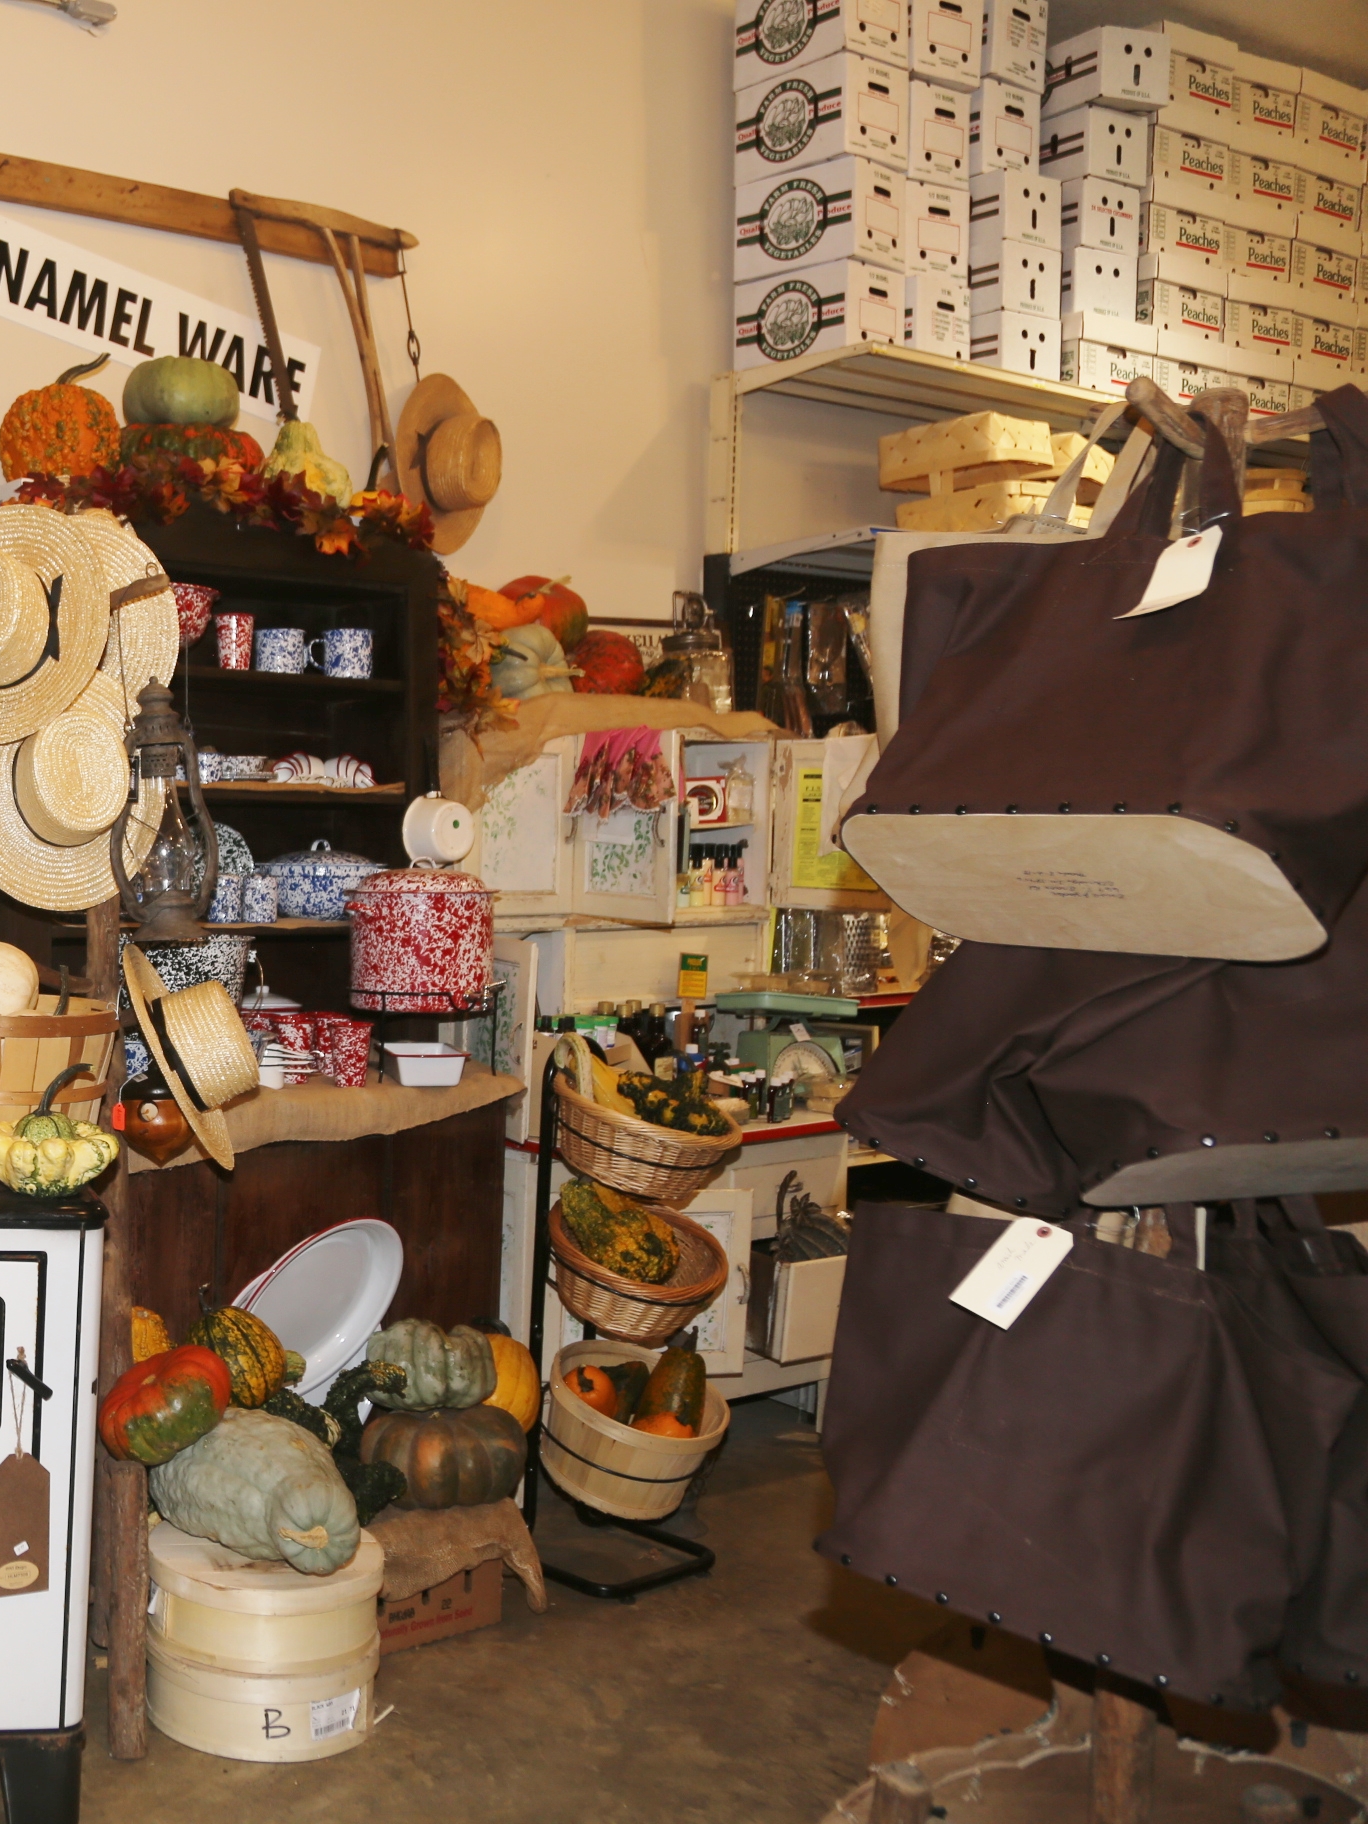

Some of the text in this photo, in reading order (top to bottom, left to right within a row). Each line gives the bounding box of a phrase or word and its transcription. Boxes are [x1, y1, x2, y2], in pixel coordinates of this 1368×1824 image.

[807, 0, 840, 15] Poduce
[759, 28, 813, 64] VEGETABLES
[760, 80, 815, 114] FARM FRESH
[1188, 74, 1230, 101] Peaches
[808, 100, 842, 117] Poduce
[1252, 100, 1292, 123] Peaches
[760, 127, 813, 161] VEGETABLES
[1321, 121, 1359, 147] Peaches
[1182, 150, 1224, 175] Peaches
[1252, 172, 1292, 195] Peaches
[764, 180, 824, 211] FARM FRESH
[1316, 192, 1354, 217] Peaches
[817, 202, 852, 218] Poduce
[764, 229, 822, 260] VEGETABLES
[1179, 227, 1220, 250] Peaches
[1248, 247, 1287, 267] Peaches
[1316, 263, 1353, 287] Peaches
[761, 281, 818, 312] FARM FRESH
[811, 305, 845, 319] Poduce
[1181, 303, 1218, 325] Peaches
[1251, 319, 1289, 340] Peaches
[761, 330, 816, 360] VEGETABLES
[1314, 335, 1350, 357] Peaches
[1181, 378, 1209, 395] Peac
[1249, 393, 1286, 413] Peaches
[261, 1707, 291, 1739] B
